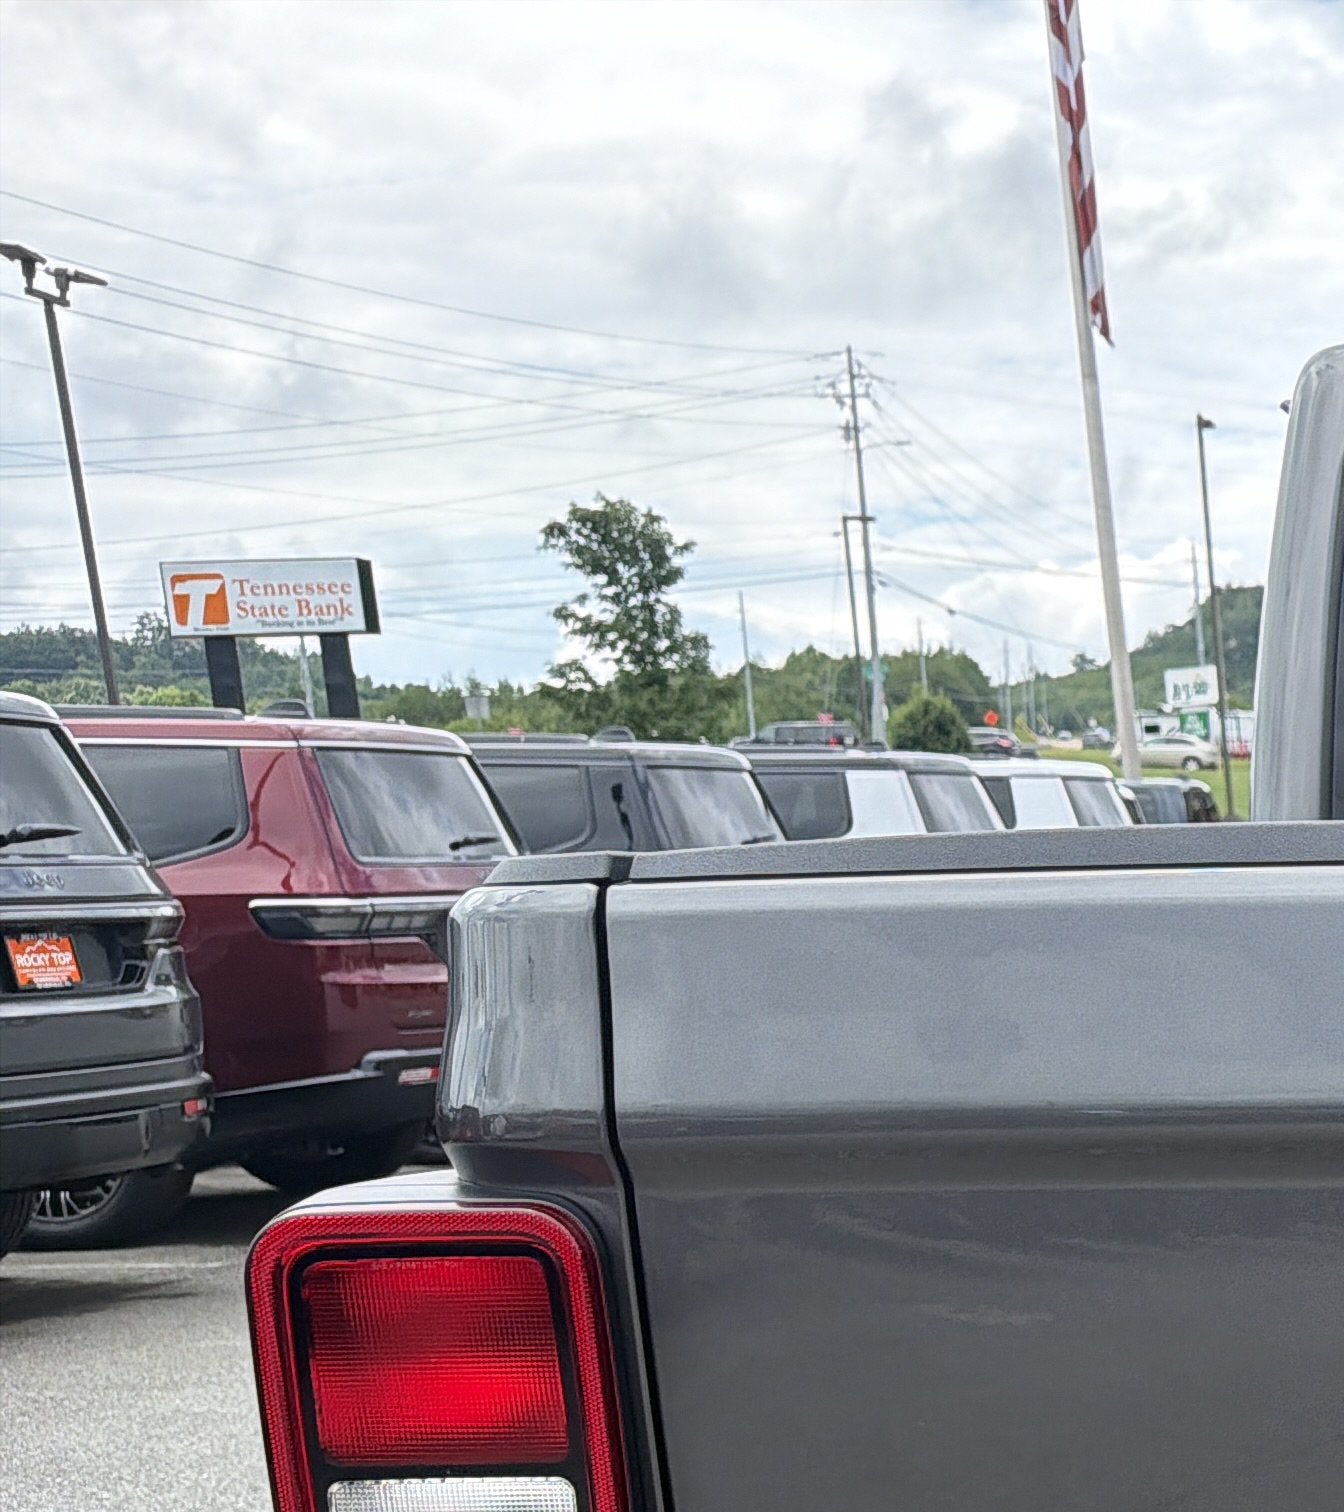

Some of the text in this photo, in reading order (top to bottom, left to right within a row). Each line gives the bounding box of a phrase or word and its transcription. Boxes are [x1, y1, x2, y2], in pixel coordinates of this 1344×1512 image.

[232, 577, 352, 597] Tennessee
[236, 597, 353, 619] State Bank
[15, 951, 73, 967] ROCKY TOP
